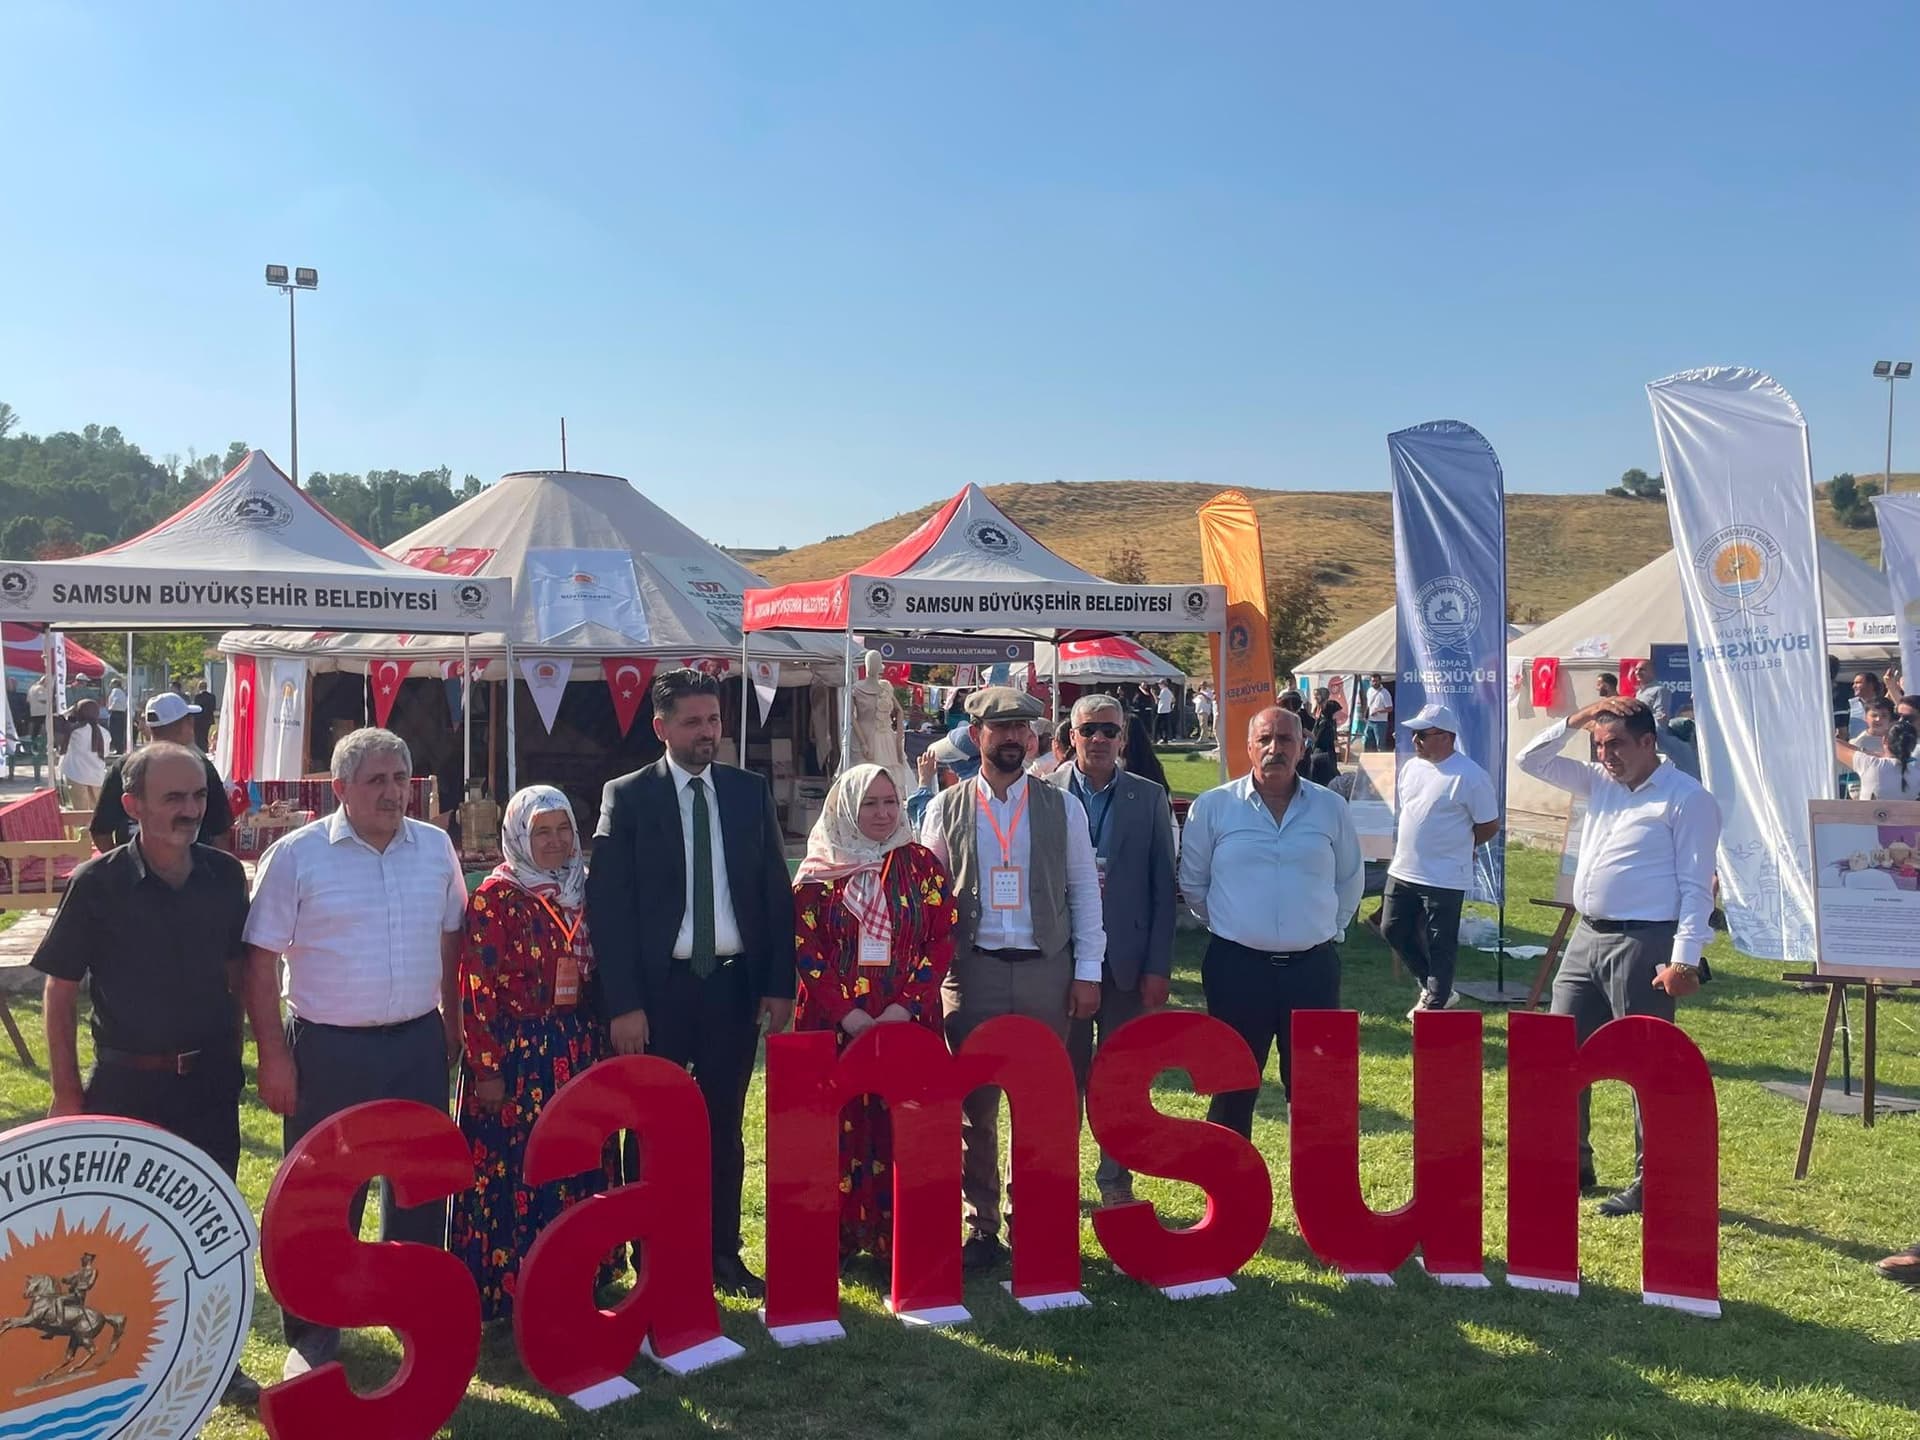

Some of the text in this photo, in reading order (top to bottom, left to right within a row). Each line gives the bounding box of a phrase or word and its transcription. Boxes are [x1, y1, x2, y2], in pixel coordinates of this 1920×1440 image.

[52, 580, 437, 611] SAMSUN BÜYÜKŞEHİR BELEDİYESİ
[905, 591, 1172, 614] SAMSUN BÜYÜKŞEHİR BELEDİYESİ
[906, 647, 997, 656] TÜDAK ARAMA KURTARMA
[133, 1158, 241, 1255] BELEDİYESİ
[260, 1009, 1720, 1440] samsun
